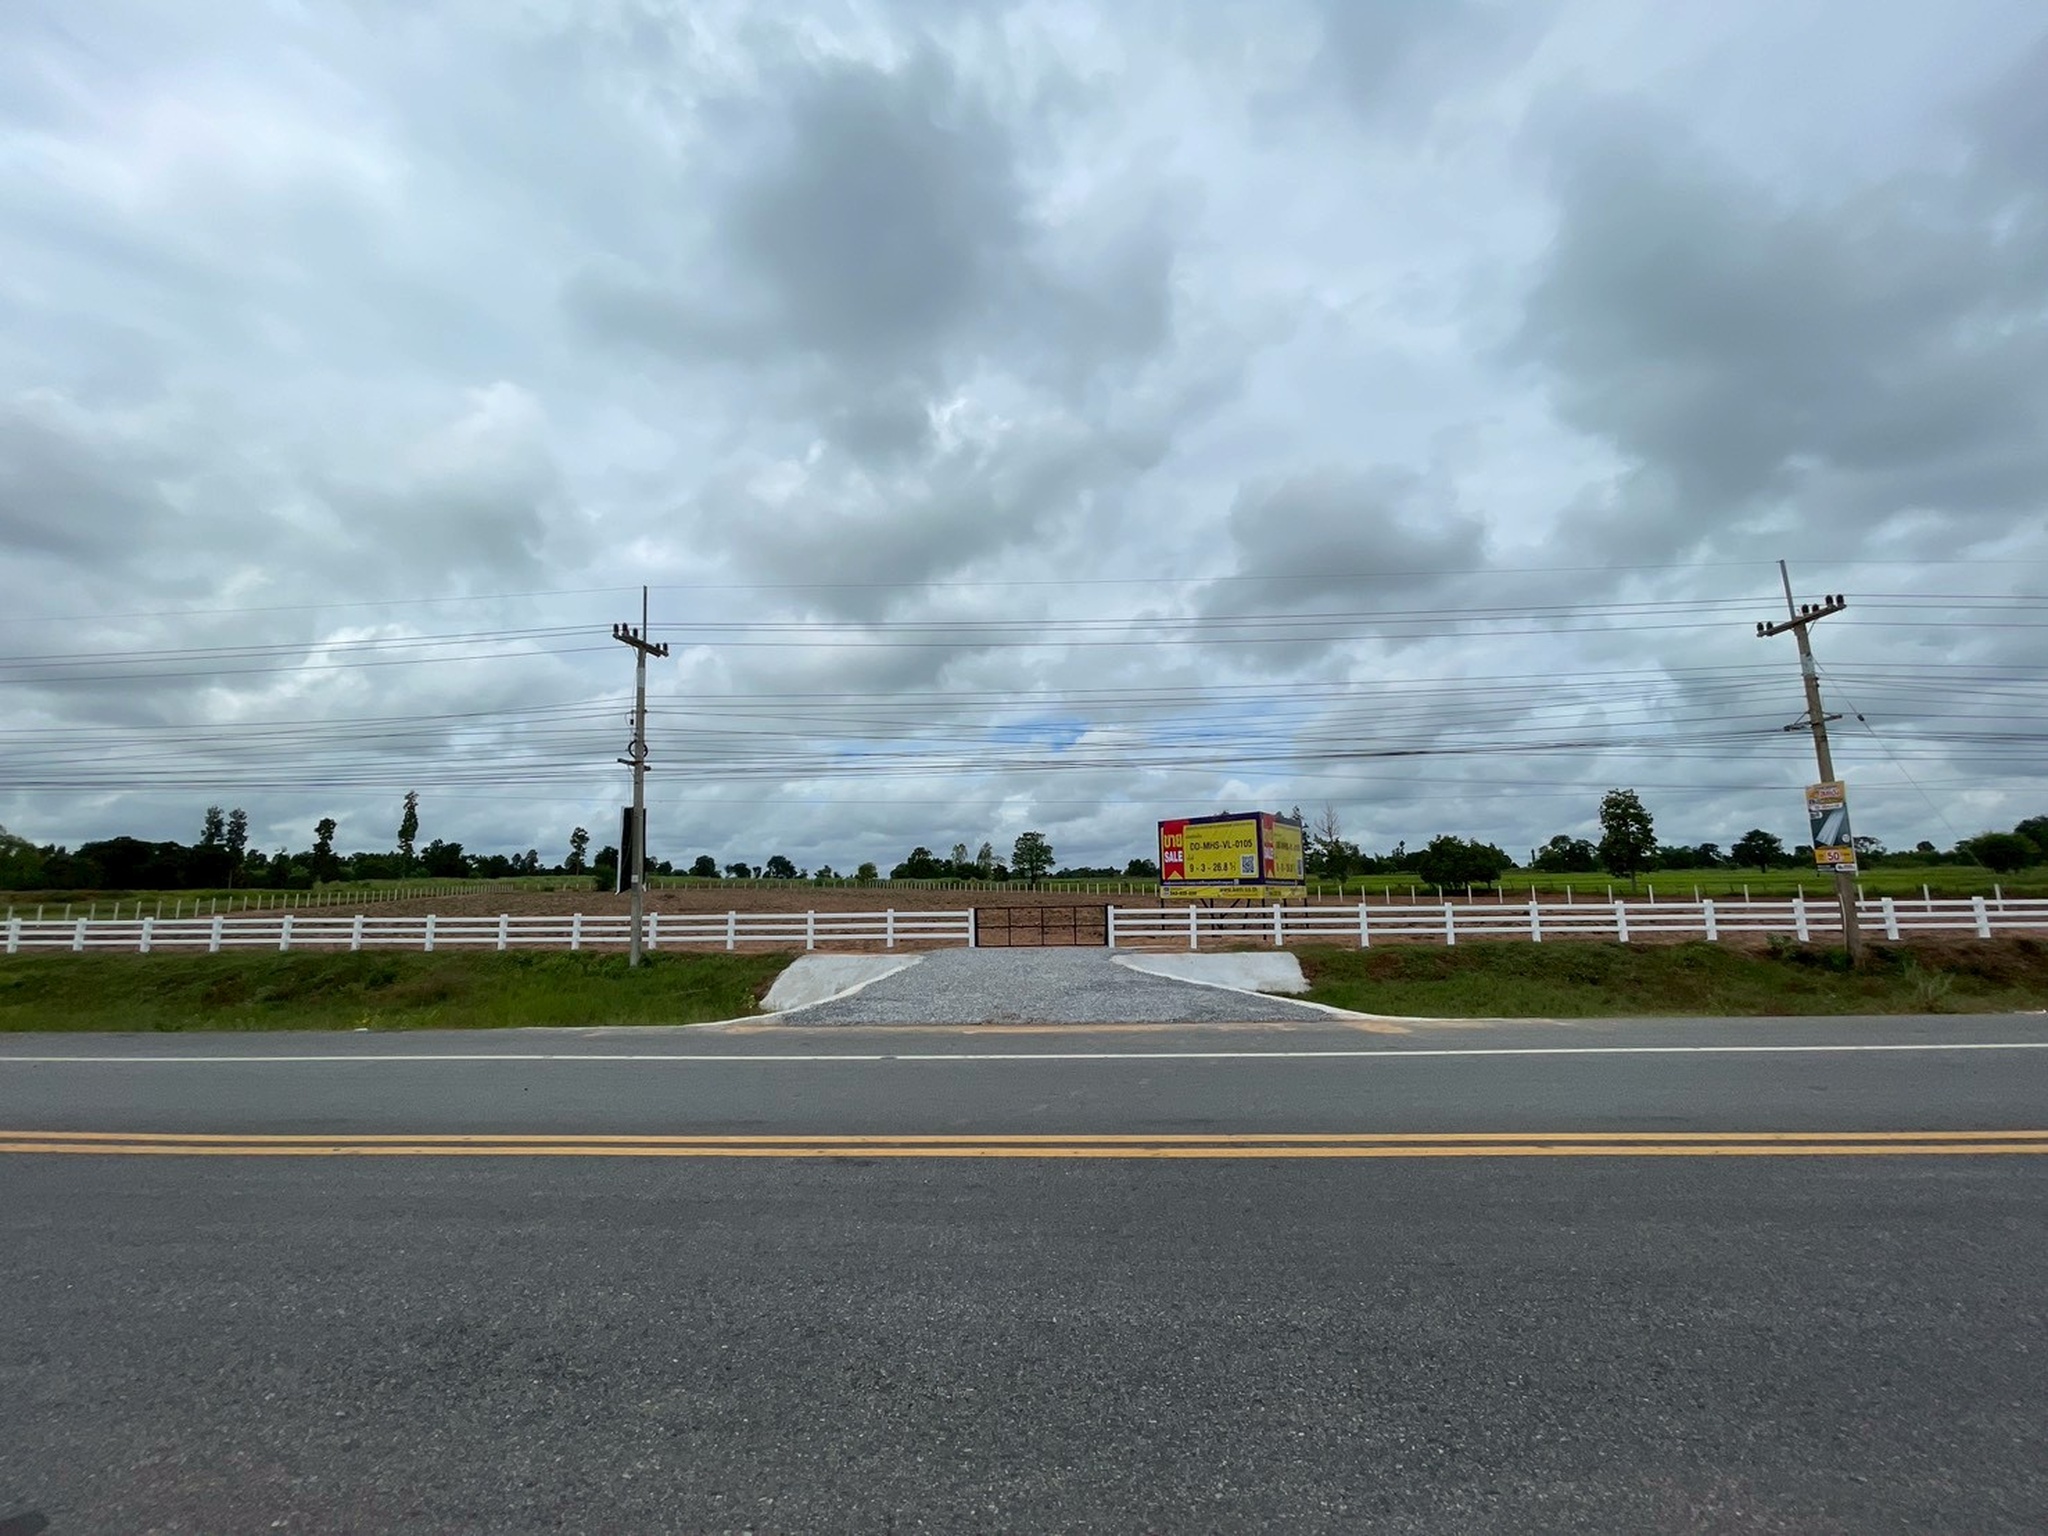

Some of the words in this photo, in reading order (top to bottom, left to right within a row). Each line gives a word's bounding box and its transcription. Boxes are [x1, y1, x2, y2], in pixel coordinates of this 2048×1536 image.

[1164, 833, 1182, 848] ขาย
[1164, 850, 1184, 863] SALE
[1827, 852, 1840, 861] 50
